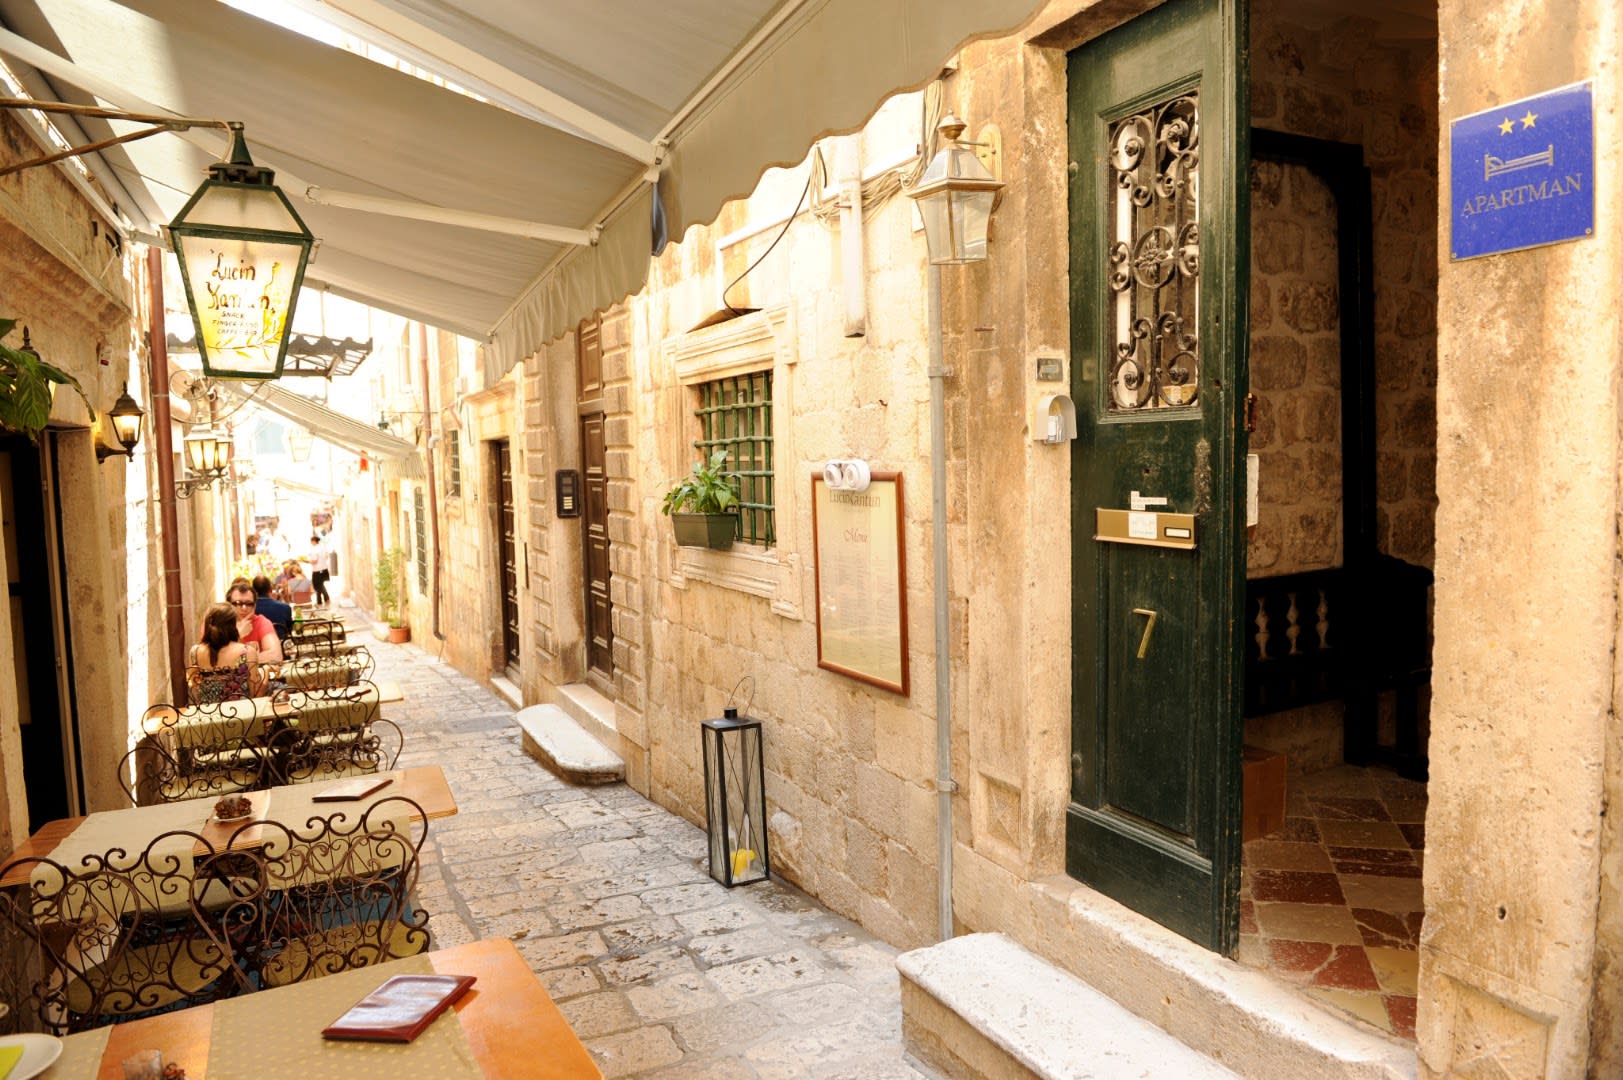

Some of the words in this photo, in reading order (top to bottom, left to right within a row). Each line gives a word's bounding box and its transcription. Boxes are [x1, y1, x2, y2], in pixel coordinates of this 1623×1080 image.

[1460, 172, 1583, 217] APARTMAN
[211, 251, 256, 281] Lucin
[1132, 607, 1157, 659] 7
